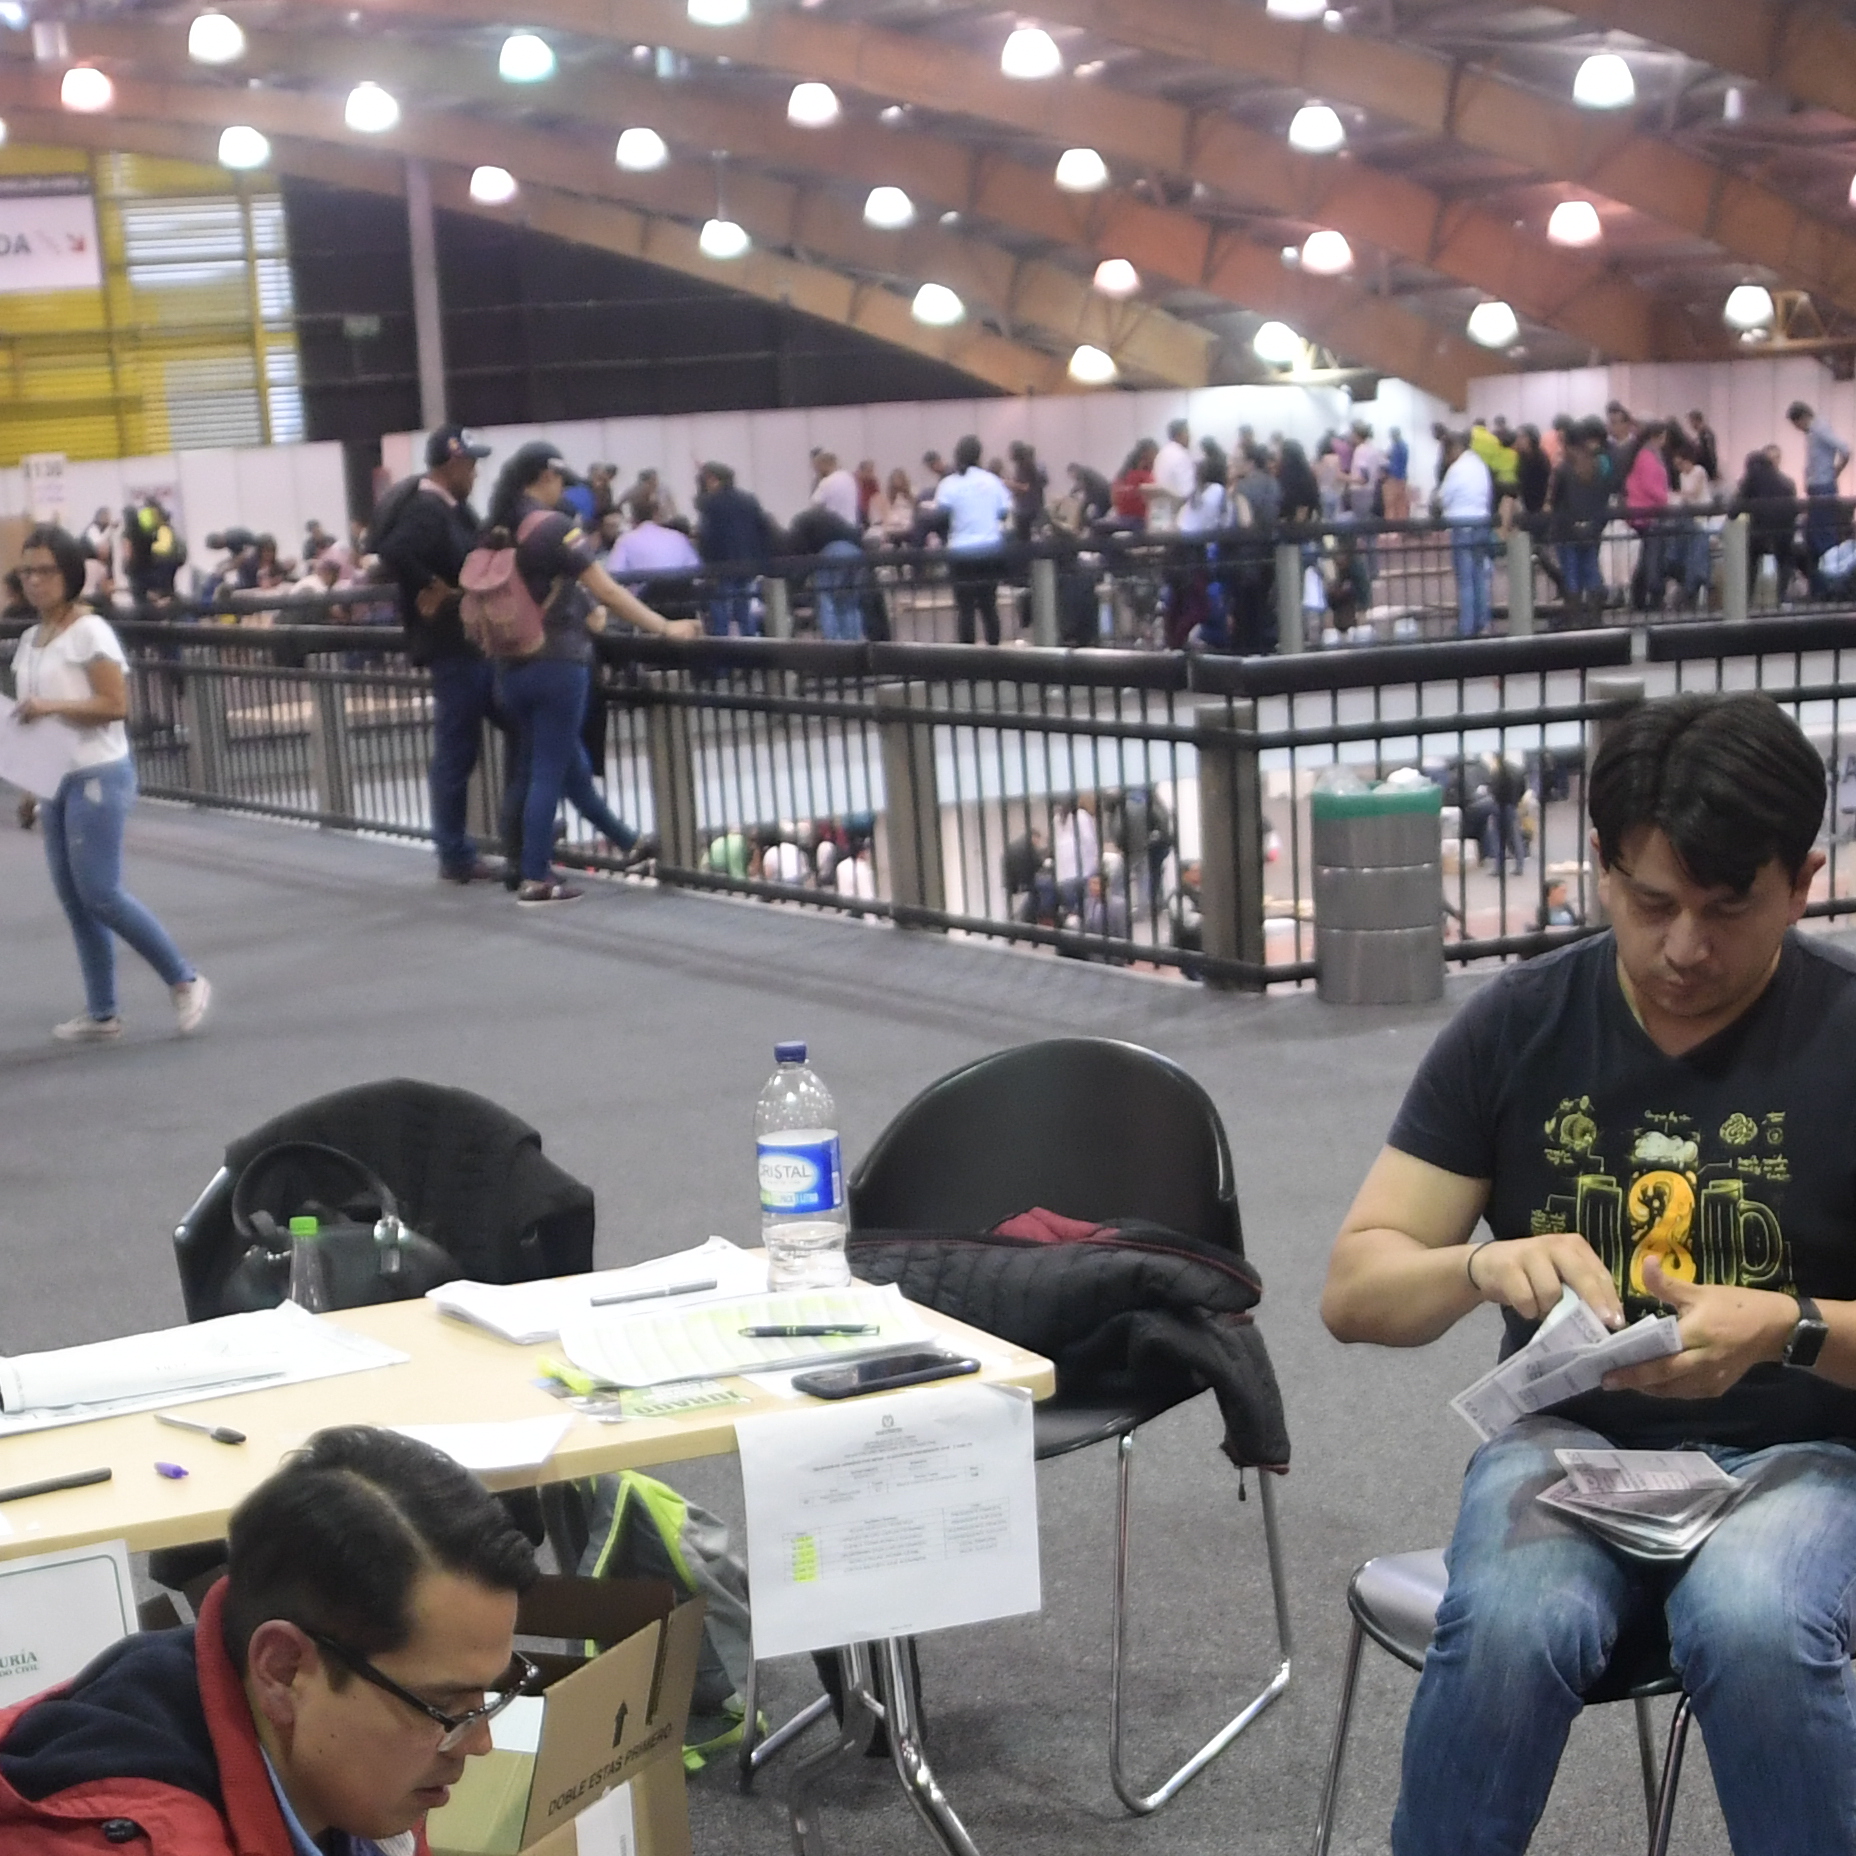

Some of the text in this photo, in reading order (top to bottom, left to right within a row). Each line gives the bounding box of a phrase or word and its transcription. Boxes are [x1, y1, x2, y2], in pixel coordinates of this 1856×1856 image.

[759, 1163, 811, 1180] CRISTAL
[15, 1663, 39, 1675] CIVIL
[548, 1723, 673, 1817] DOBLE ESTAS PRIMERO
